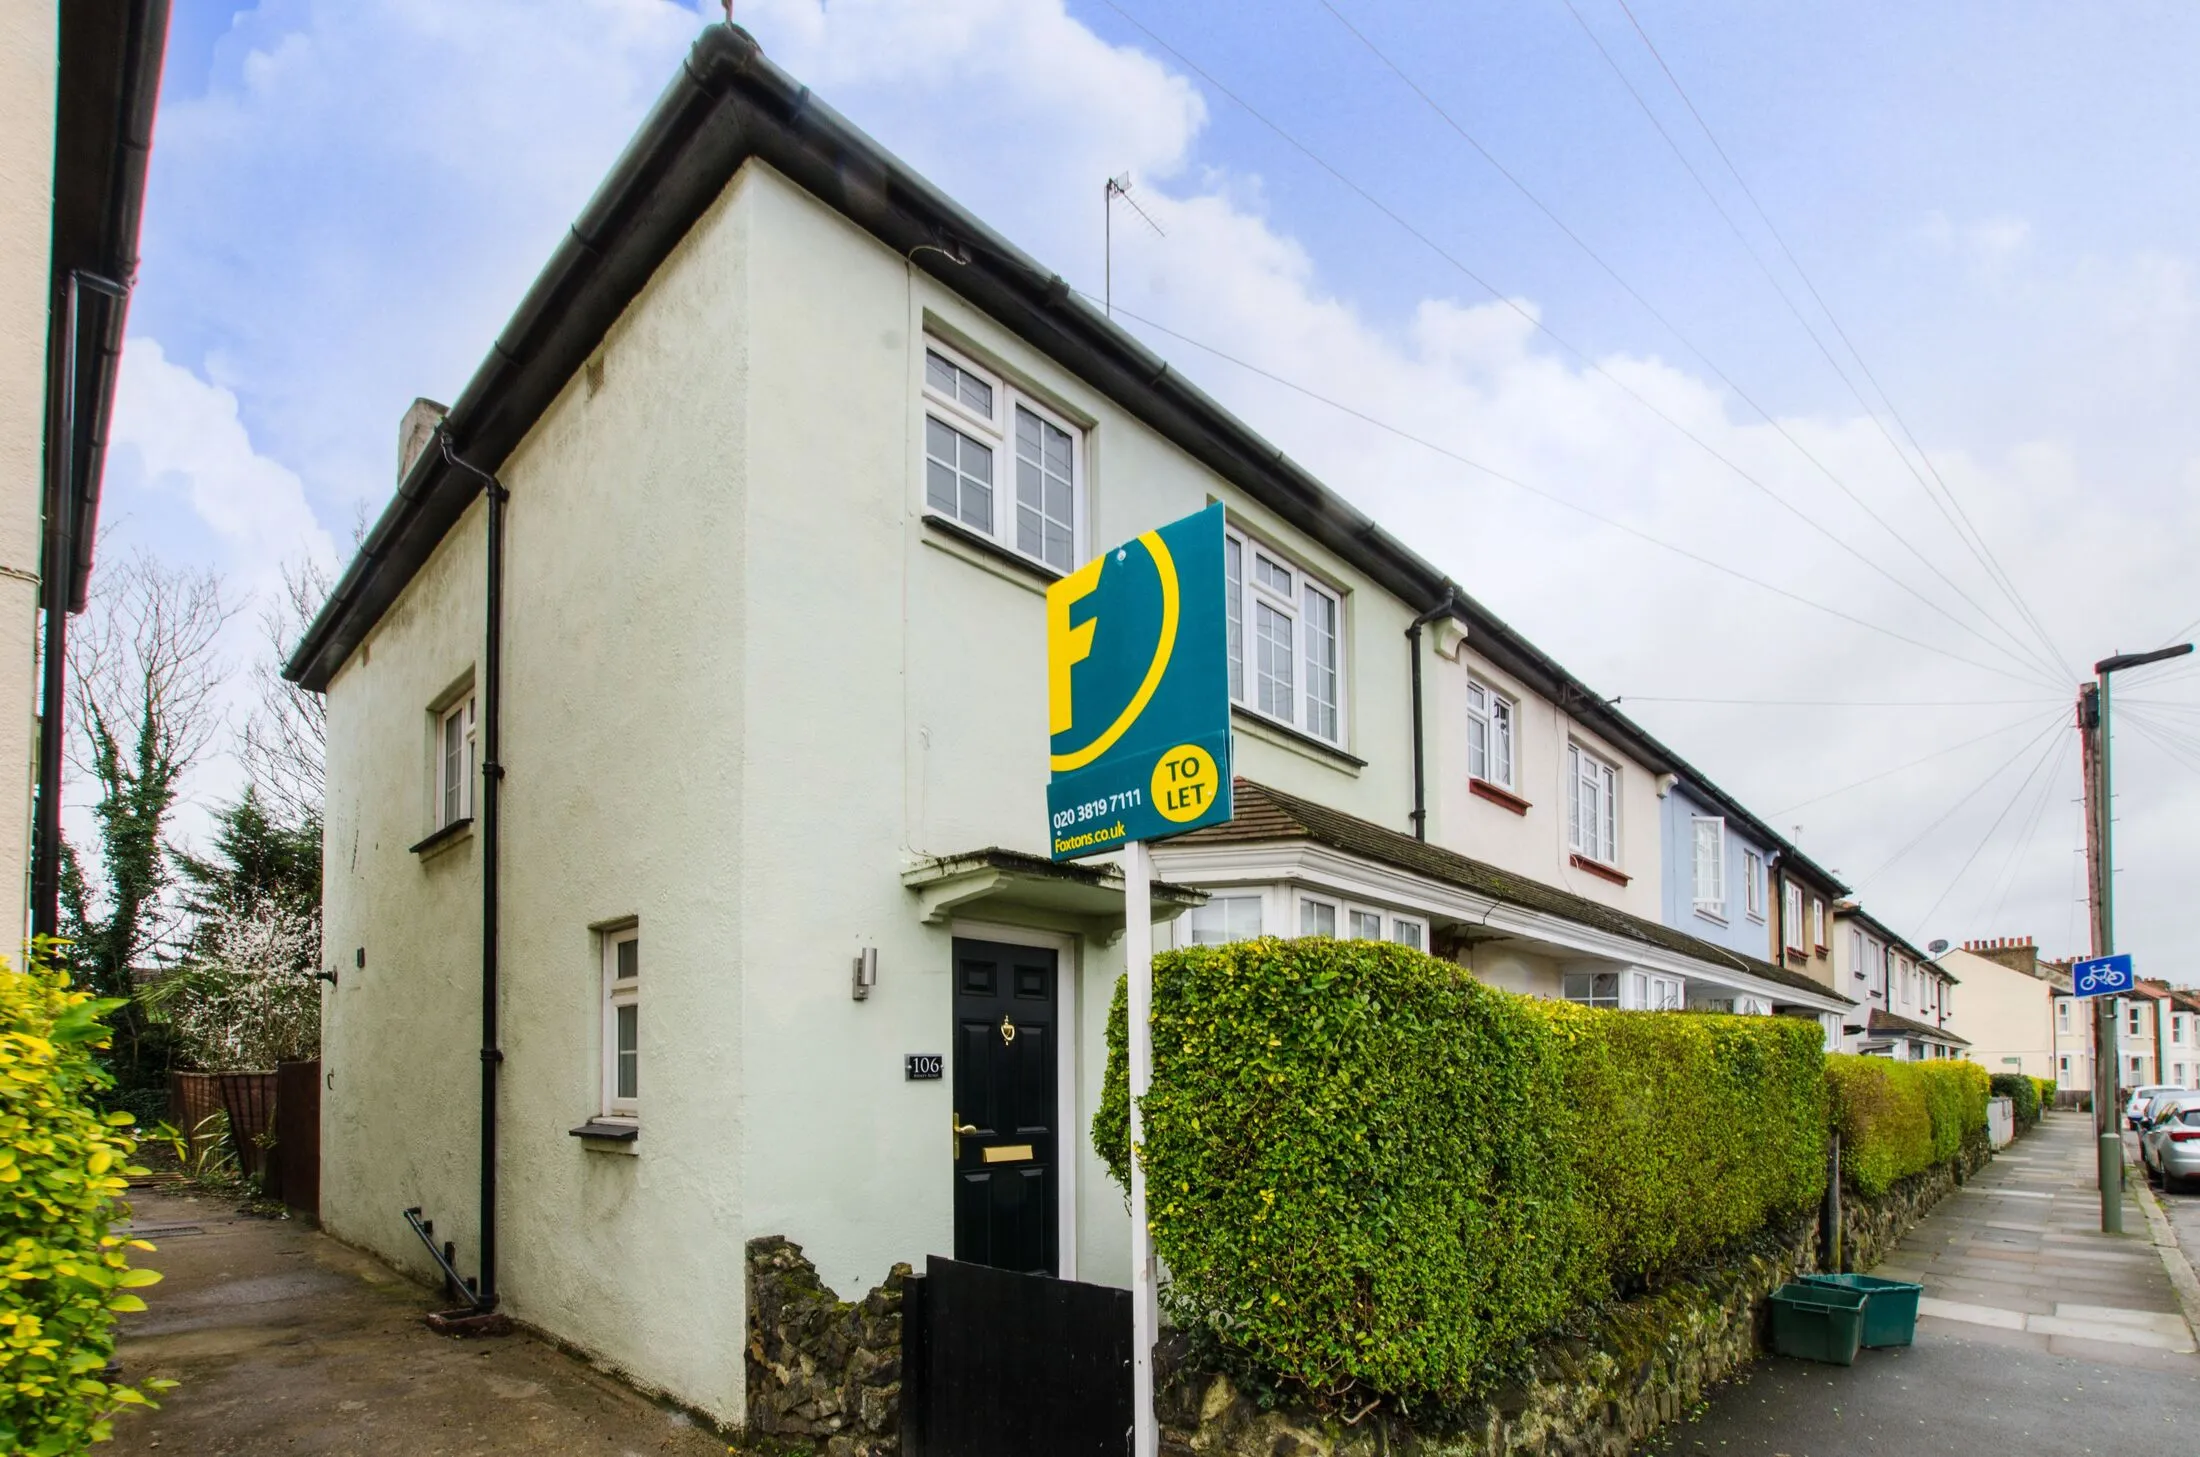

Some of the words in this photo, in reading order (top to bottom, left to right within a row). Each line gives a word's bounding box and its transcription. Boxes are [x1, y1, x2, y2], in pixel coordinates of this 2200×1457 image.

[1166, 757, 1200, 782] TO
[1053, 809, 1075, 829] 020
[1077, 798, 1107, 822] 3819
[1109, 788, 1141, 812] 7111
[1167, 783, 1205, 811] LET
[1055, 820, 1126, 853] Foxtons.co.uk
[914, 1057, 939, 1073] 106
